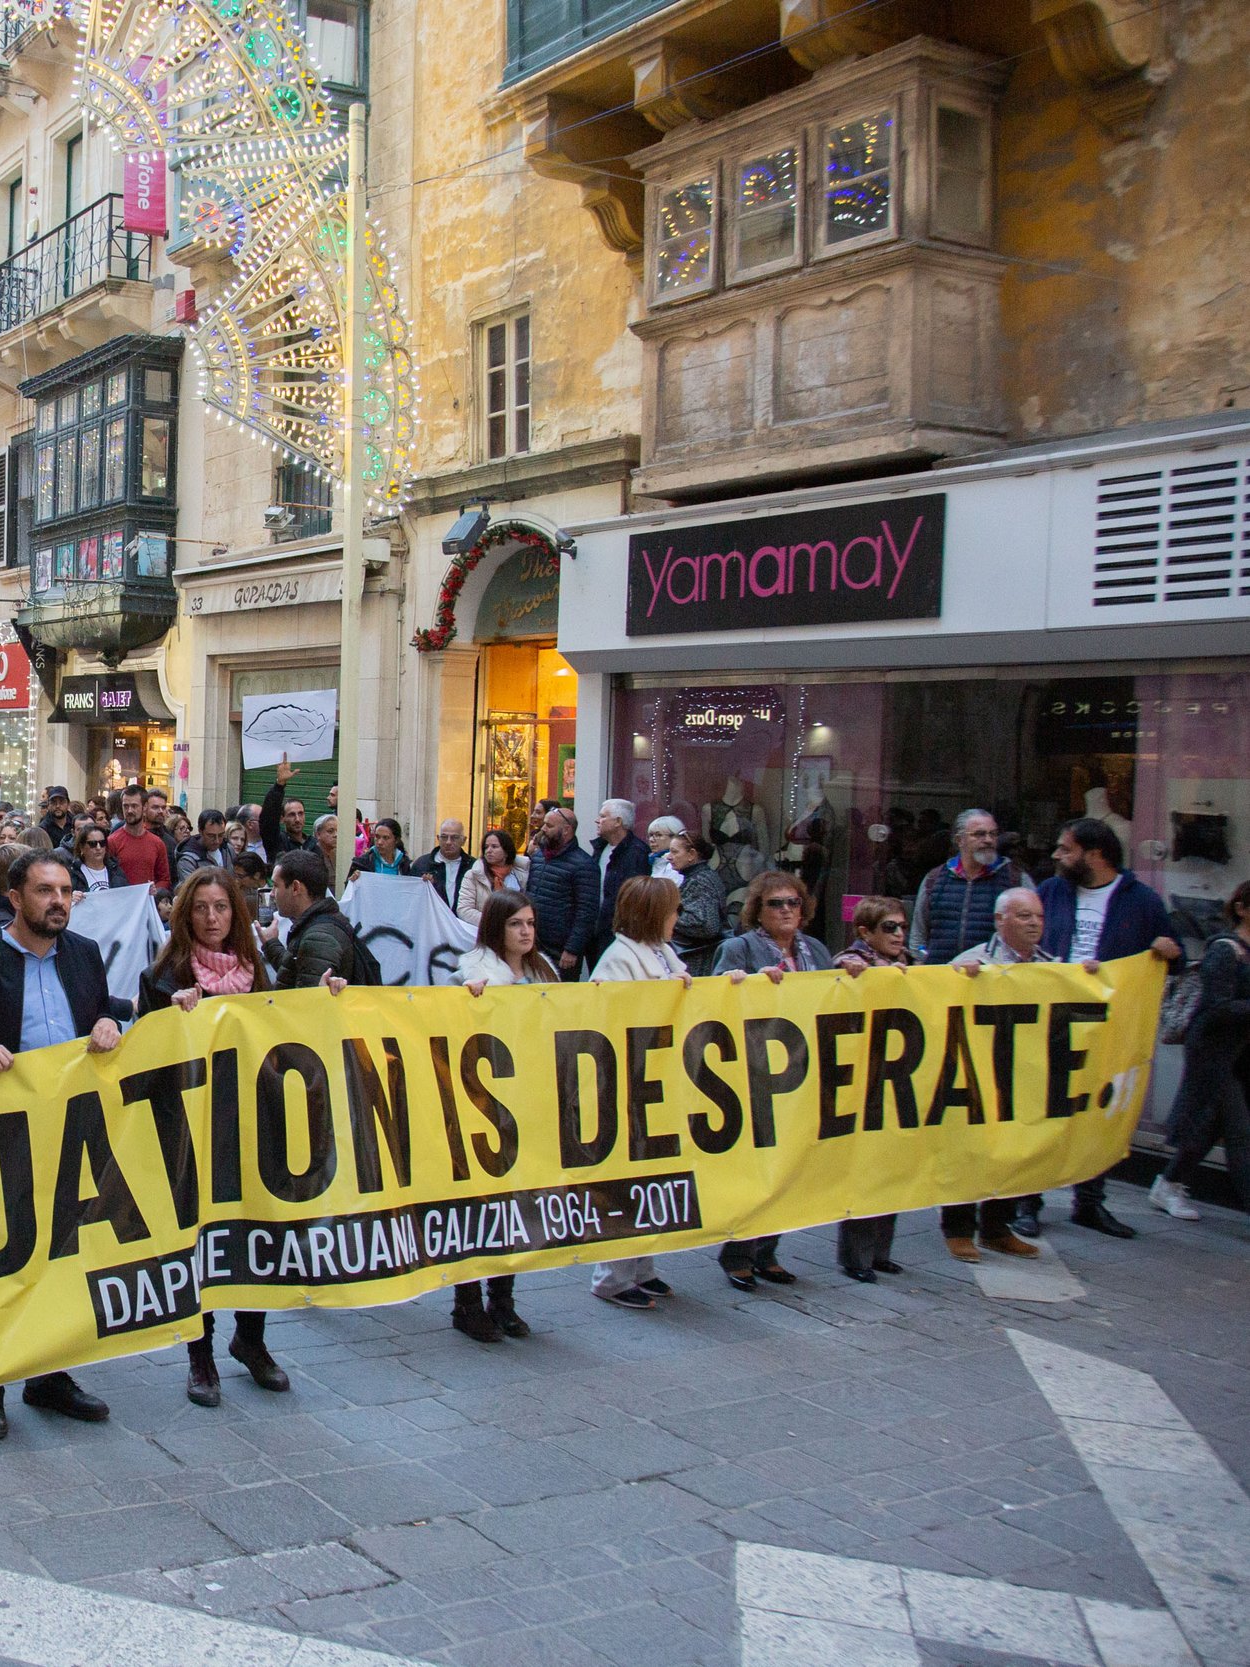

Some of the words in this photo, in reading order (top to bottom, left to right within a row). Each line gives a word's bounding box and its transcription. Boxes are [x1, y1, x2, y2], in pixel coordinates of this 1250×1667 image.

[234, 581, 300, 607] GOPALDAS
[642, 516, 924, 618] yamamay
[64, 692, 94, 709] FRANKS
[429, 1032, 519, 1182] IS
[247, 1213, 419, 1278] CARUANA
[424, 1200, 530, 1258] GALIZIA
[536, 1191, 602, 1241] 1964
[630, 1179, 690, 1229] 2017
